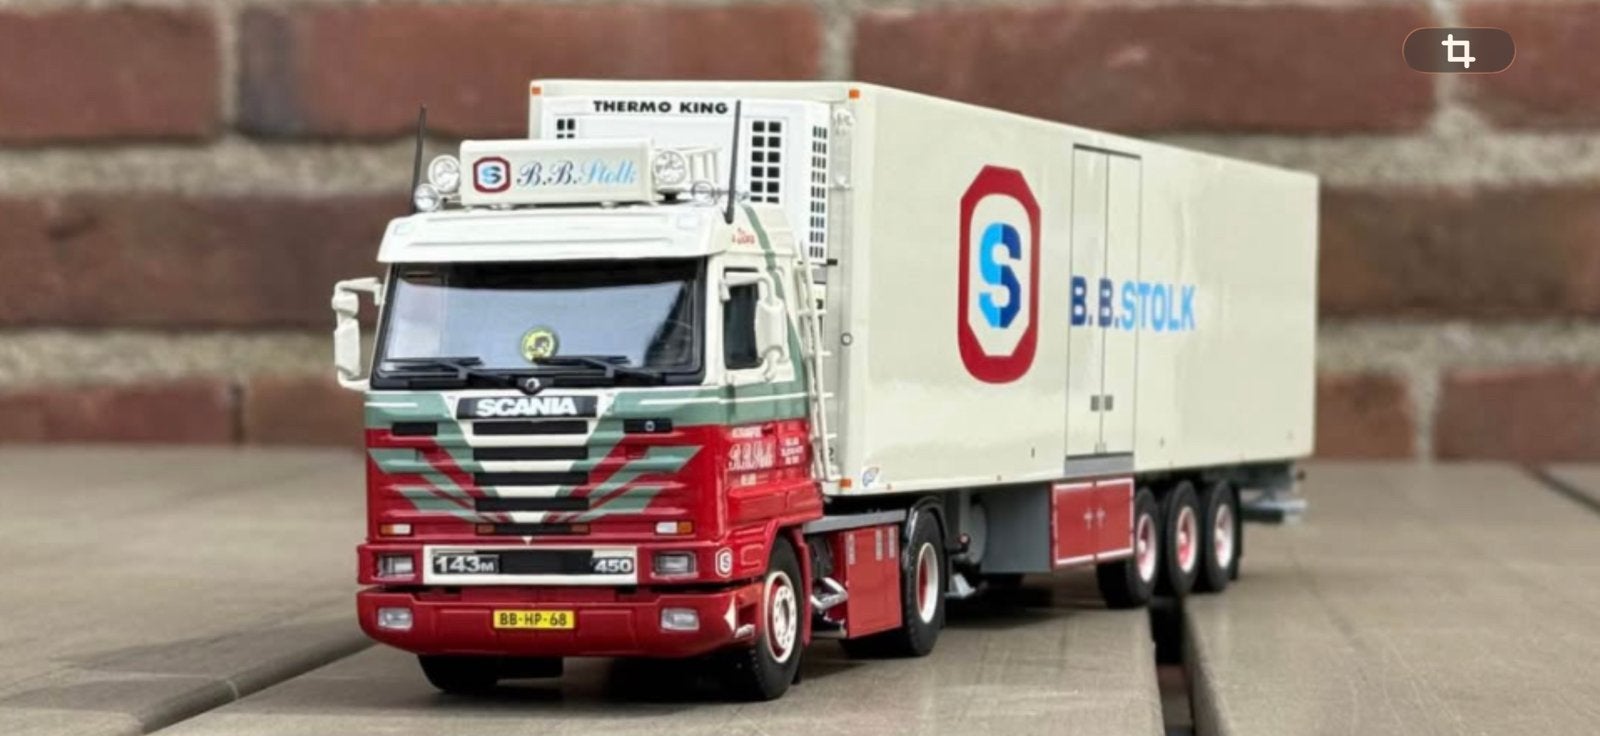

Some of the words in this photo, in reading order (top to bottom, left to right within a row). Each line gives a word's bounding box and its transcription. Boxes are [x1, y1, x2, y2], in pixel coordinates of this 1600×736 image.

[593, 100, 672, 113] THERMO
[680, 101, 729, 115] KING
[482, 165, 502, 185] S
[979, 223, 1021, 328] S
[475, 396, 577, 417] SCANIA
[593, 558, 632, 573] 450
[499, 612, 568, 626] BB-HP-68
